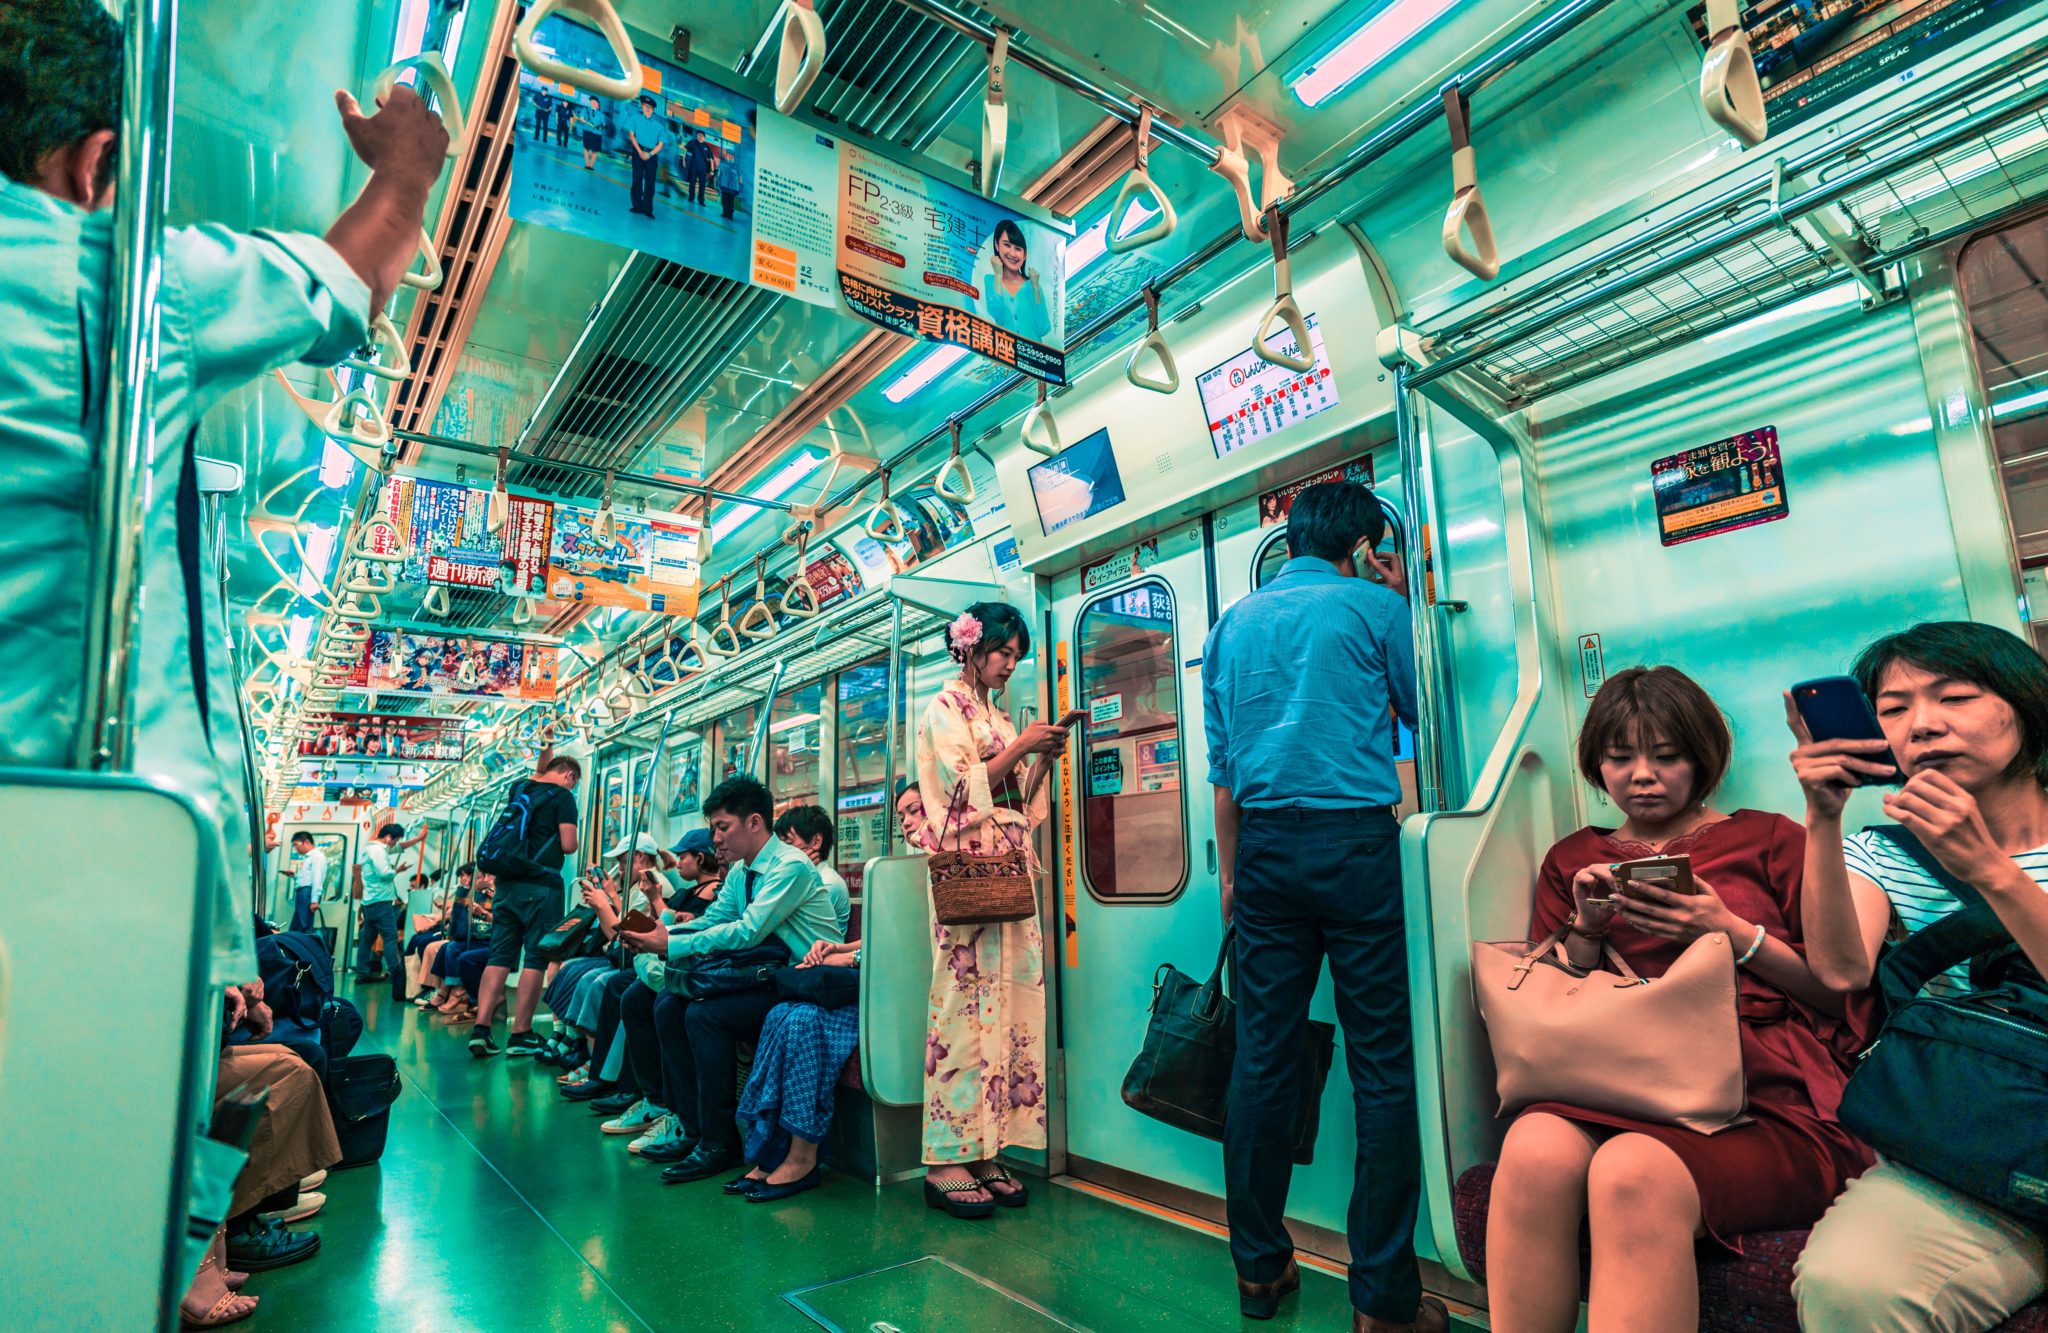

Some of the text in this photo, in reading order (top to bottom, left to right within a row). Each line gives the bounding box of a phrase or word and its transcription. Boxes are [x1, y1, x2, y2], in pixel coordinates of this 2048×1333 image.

[1879, 46, 1910, 66] SPEAC
[924, 207, 986, 250] 宅建士
[808, 281, 830, 293] サービス
[841, 276, 891, 302] 合格に向けて
[844, 287, 915, 319] メダリストクラブ
[917, 304, 1016, 366] 資格講座
[1234, 377, 1242, 385] 10
[1676, 437, 1774, 480] 塚を観よう!
[430, 558, 500, 586] 週刊新潮
[1097, 564, 1131, 583] イーアイデム
[1153, 608, 1172, 620] for O
